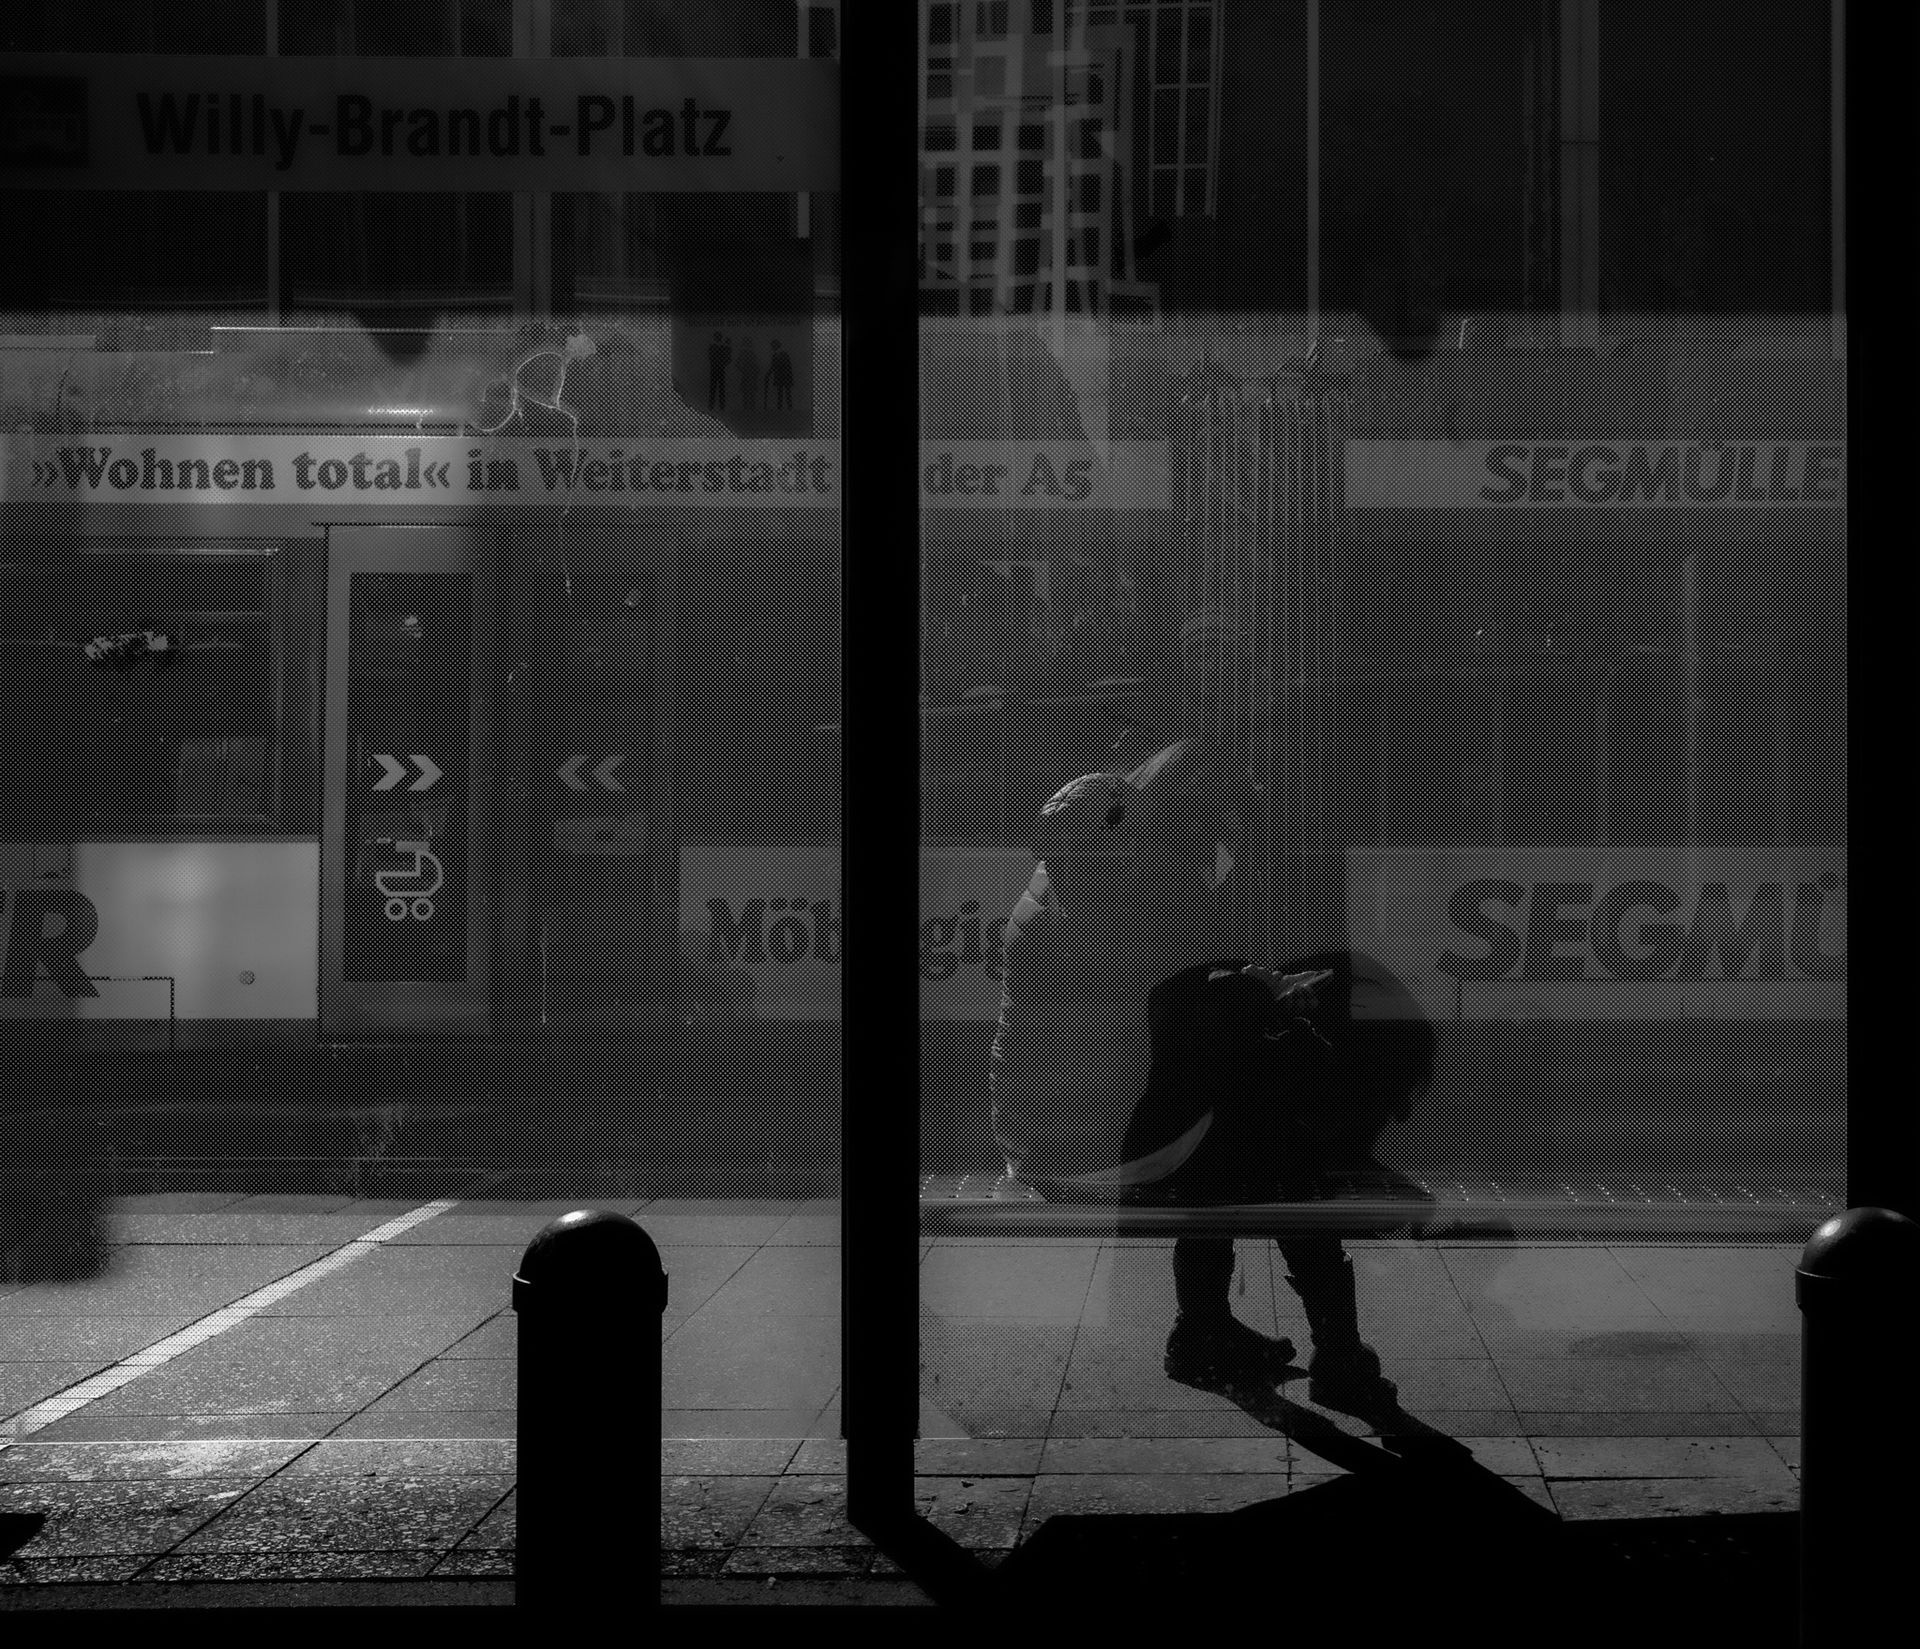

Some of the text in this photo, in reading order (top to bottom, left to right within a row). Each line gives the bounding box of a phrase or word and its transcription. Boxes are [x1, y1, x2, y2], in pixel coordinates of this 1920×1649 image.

[136, 92, 732, 171] Willy-Brandt-Platz
[467, 448, 521, 491] in
[533, 447, 832, 494] Weiterstadt
[923, 452, 1009, 496] der
[1020, 452, 1093, 501] A5
